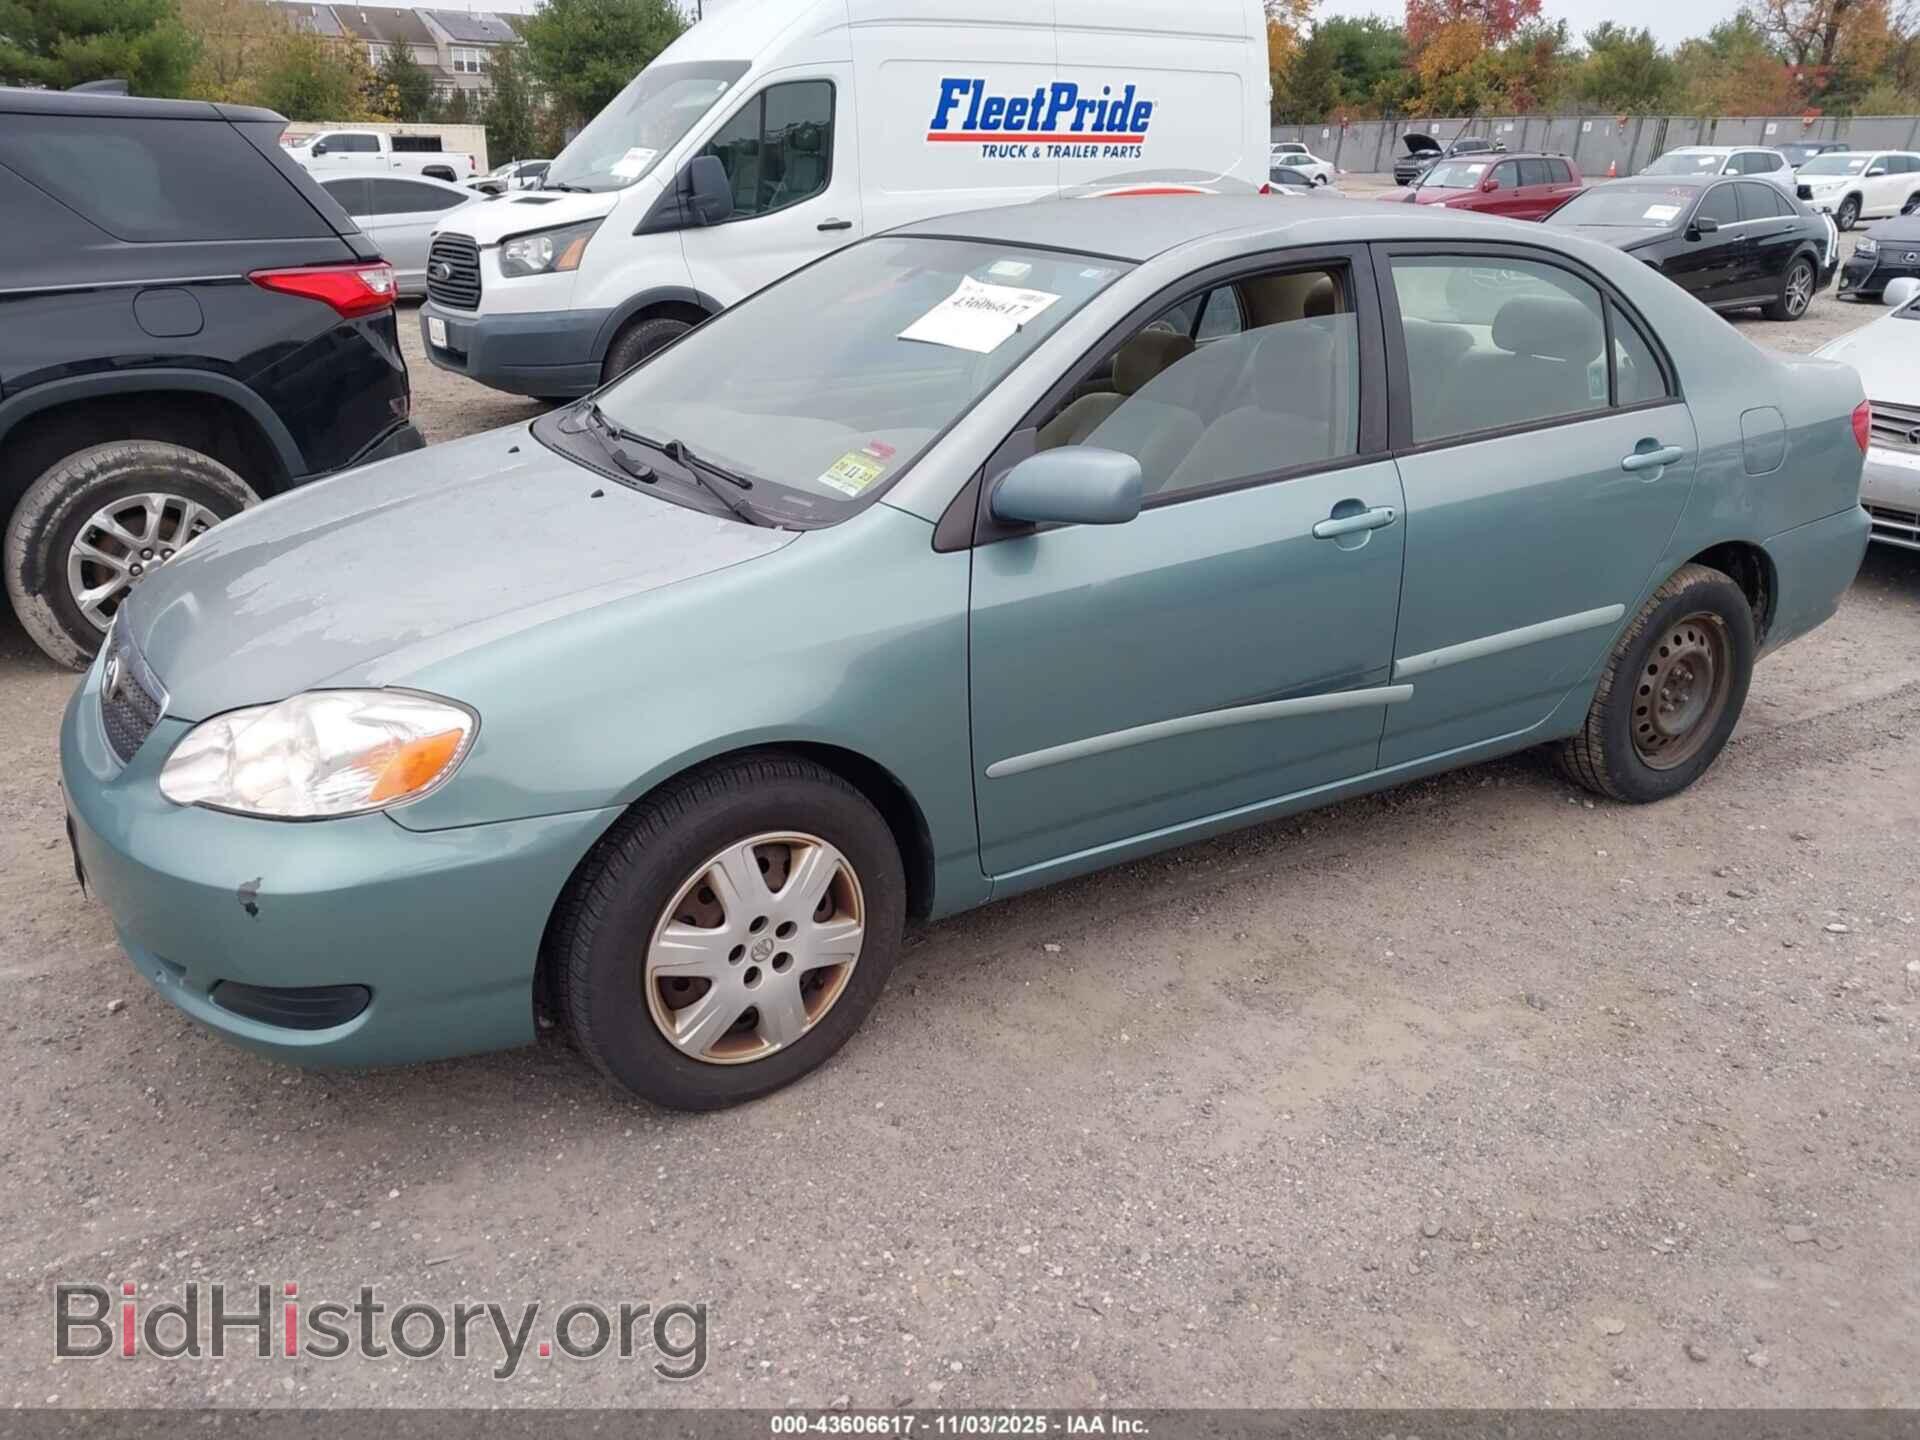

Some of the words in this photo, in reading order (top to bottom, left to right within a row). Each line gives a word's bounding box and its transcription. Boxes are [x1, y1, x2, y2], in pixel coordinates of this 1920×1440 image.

[930, 78, 1153, 132] FleetPride
[982, 144, 1028, 158] TRUCK
[1032, 145, 1040, 158] &
[1047, 144, 1098, 158] TRAILER
[1102, 145, 1142, 158] PARTS
